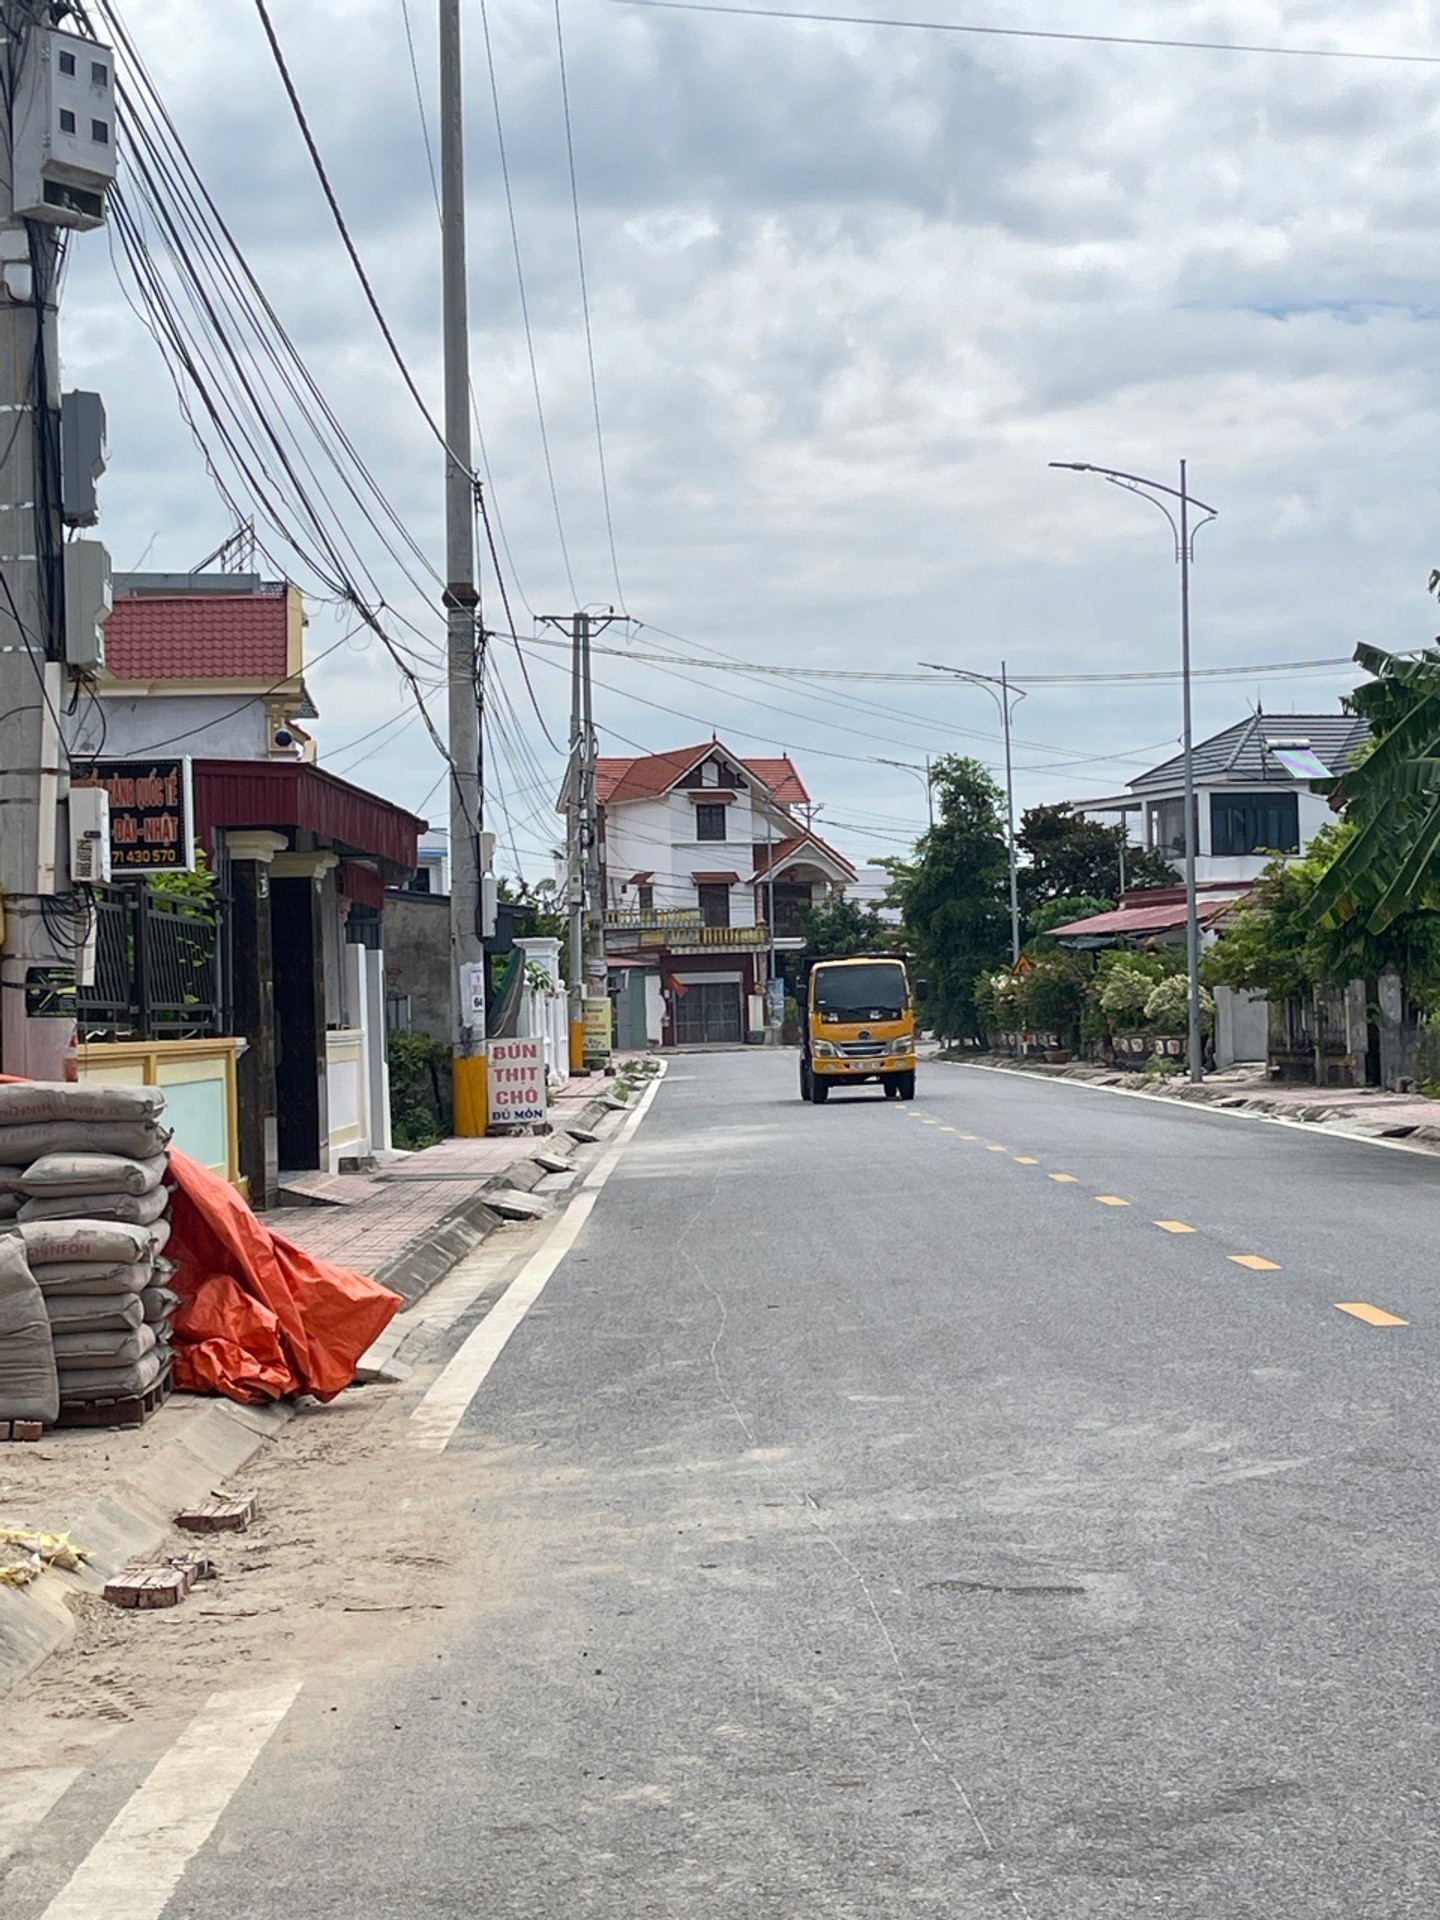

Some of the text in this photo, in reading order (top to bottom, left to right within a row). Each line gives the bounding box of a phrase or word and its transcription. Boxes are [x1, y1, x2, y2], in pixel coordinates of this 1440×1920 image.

[126, 849, 151, 863] 430
[152, 849, 176, 862] 570
[493, 1042, 537, 1060] BÚN
[494, 1066, 538, 1084] THỊT
[495, 1086, 538, 1105] CHÓ
